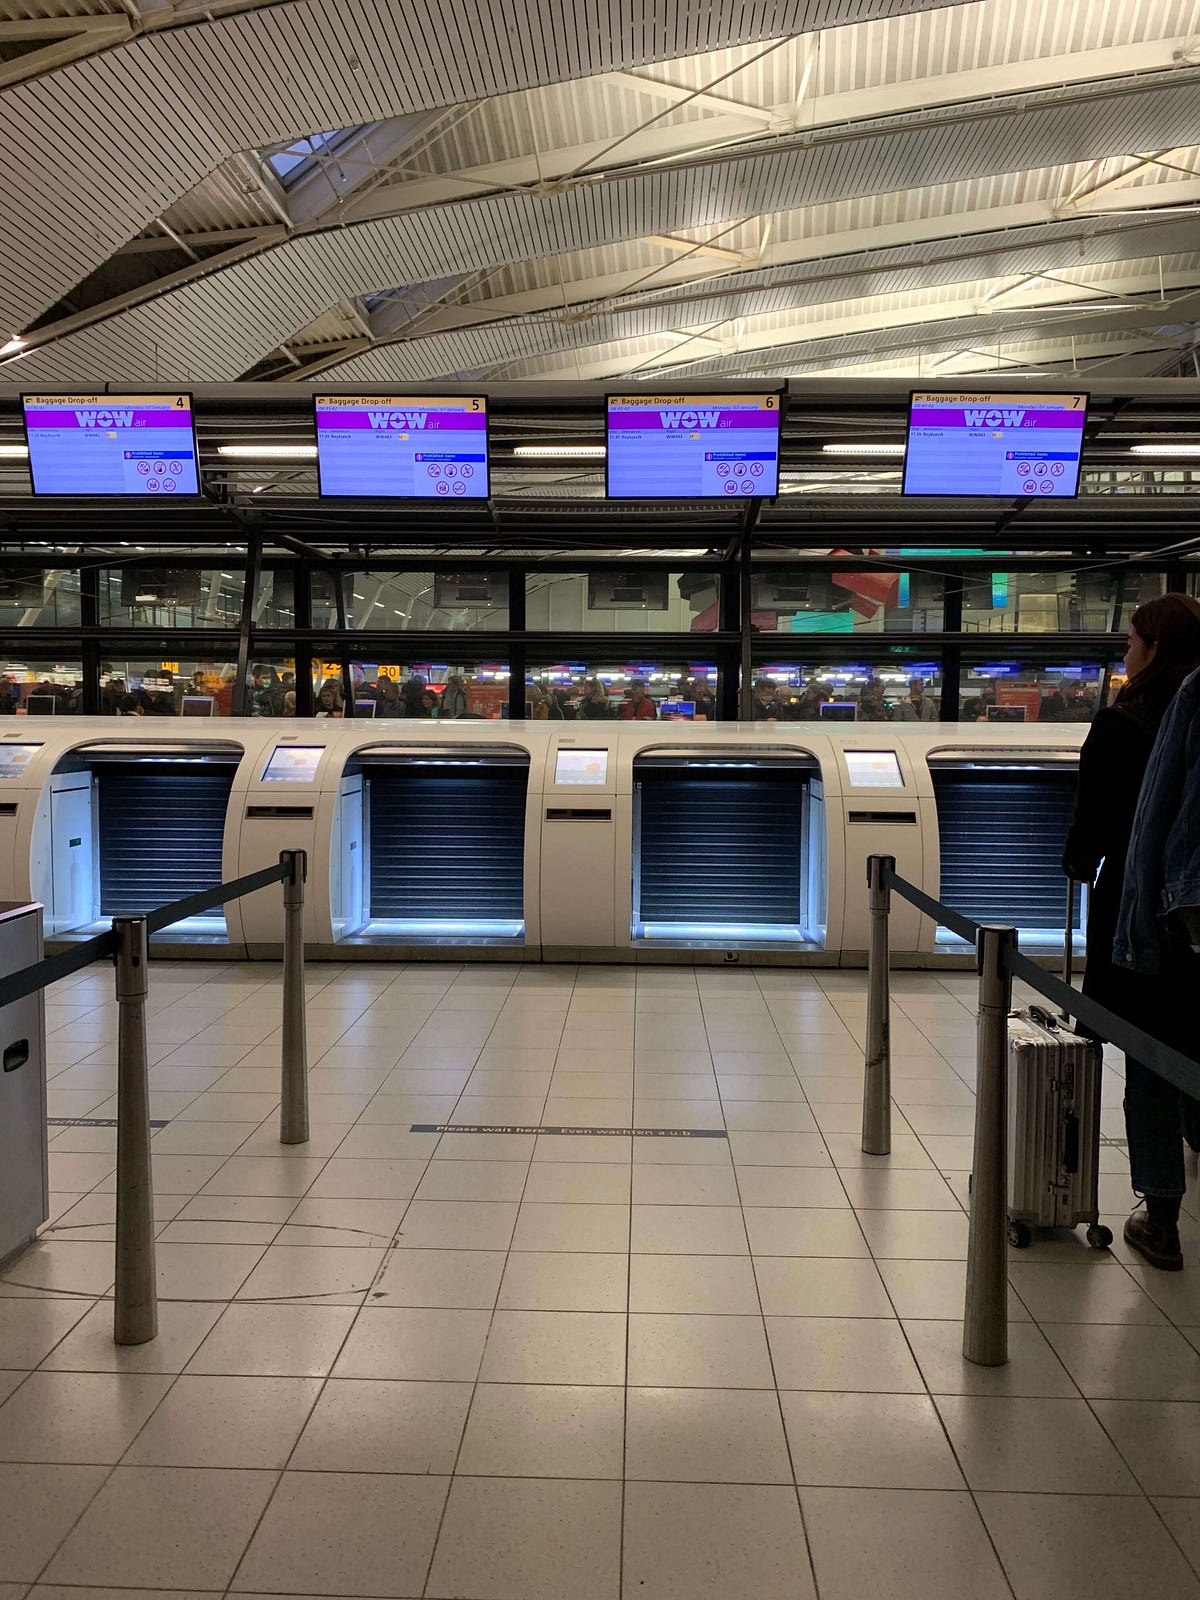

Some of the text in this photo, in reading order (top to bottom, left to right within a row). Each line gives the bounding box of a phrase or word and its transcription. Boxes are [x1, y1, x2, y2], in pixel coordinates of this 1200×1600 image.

[36, 397, 66, 405] Baggage
[176, 398, 184, 408] 4
[329, 398, 360, 406] Baggage
[472, 400, 479, 411] 5
[654, 397, 685, 405] Drop-off
[766, 397, 774, 408] 6
[959, 396, 991, 404] Drop-off
[1073, 397, 1080, 408] 7
[75, 411, 147, 427] WOW air
[368, 412, 441, 429] WOW air
[660, 411, 733, 428] WOW air
[964, 410, 1037, 427] WOW air
[382, 666, 396, 677] 30
[596, 1128, 654, 1136] wachten
[657, 1129, 695, 1137] a.u.b.
